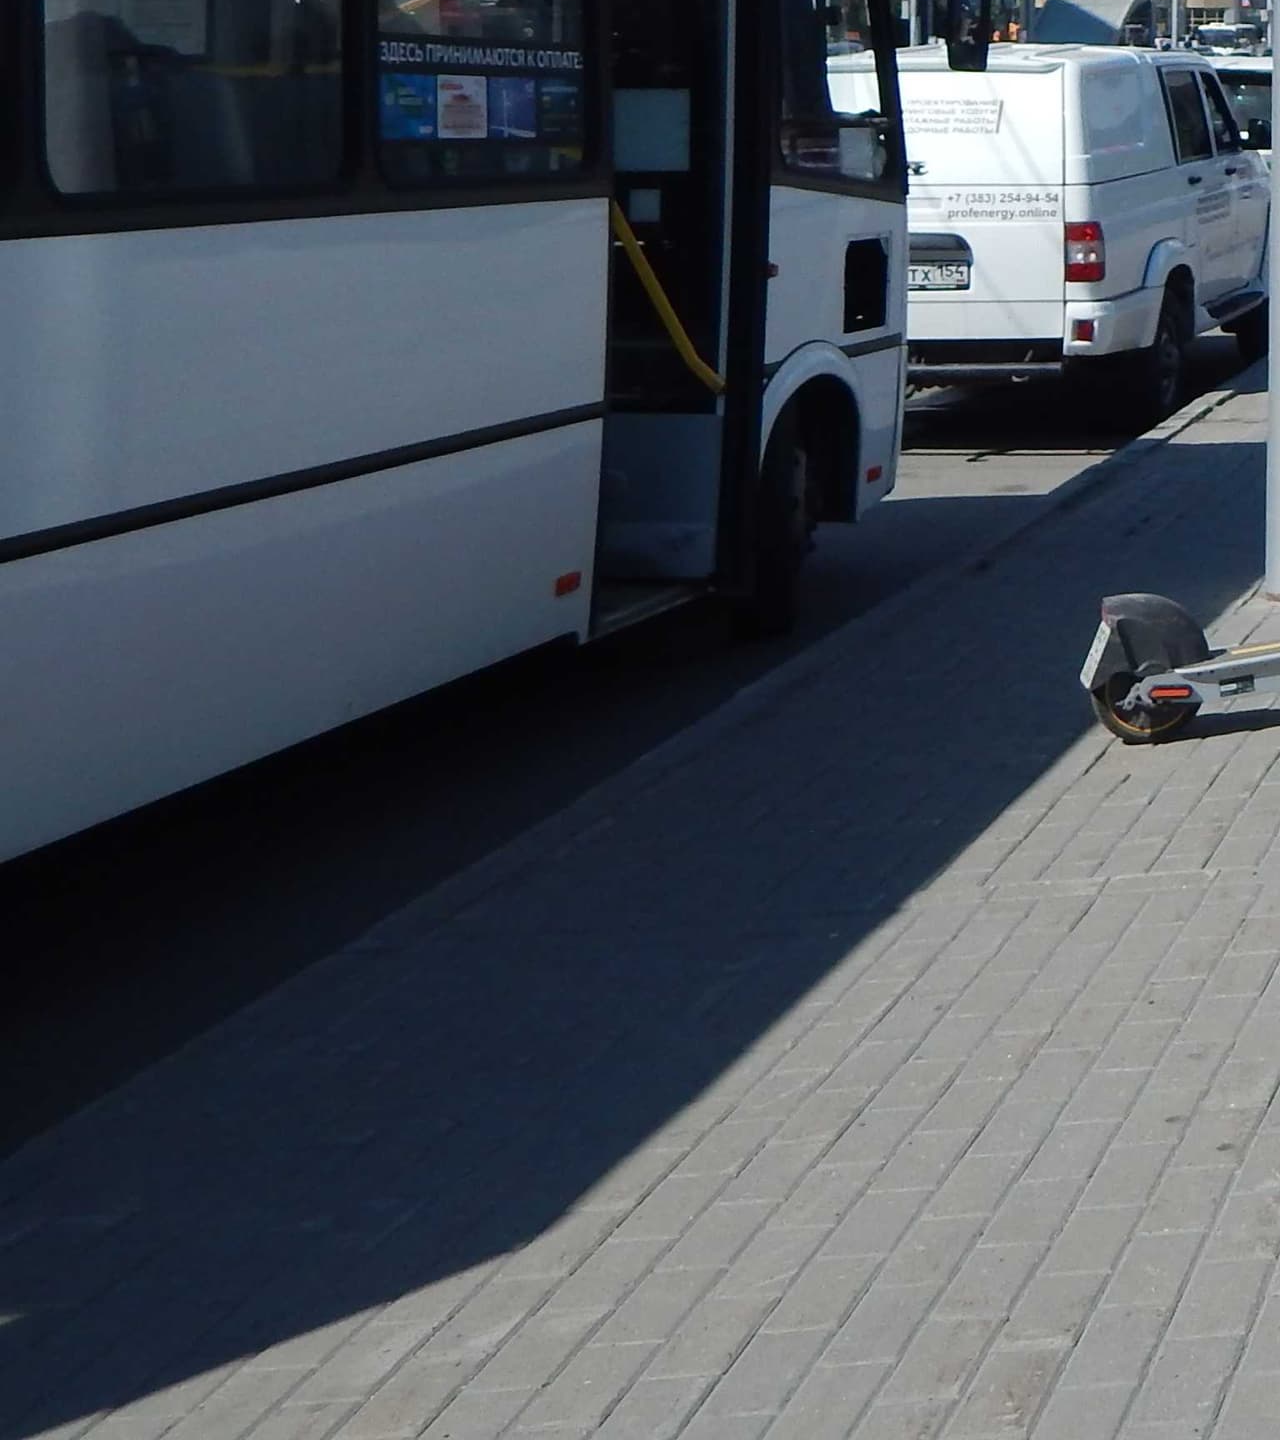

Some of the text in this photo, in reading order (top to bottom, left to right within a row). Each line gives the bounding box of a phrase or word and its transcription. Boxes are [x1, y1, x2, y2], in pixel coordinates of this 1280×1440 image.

[380, 41, 584, 69] ЗДЕСЬ ПРИНИМАЮТСЯ К ОПЛАТЕ:
[948, 192, 1059, 205] +7 (383) 254-94-54
[948, 207, 1057, 219] profenergy.online
[937, 264, 965, 278] 154
